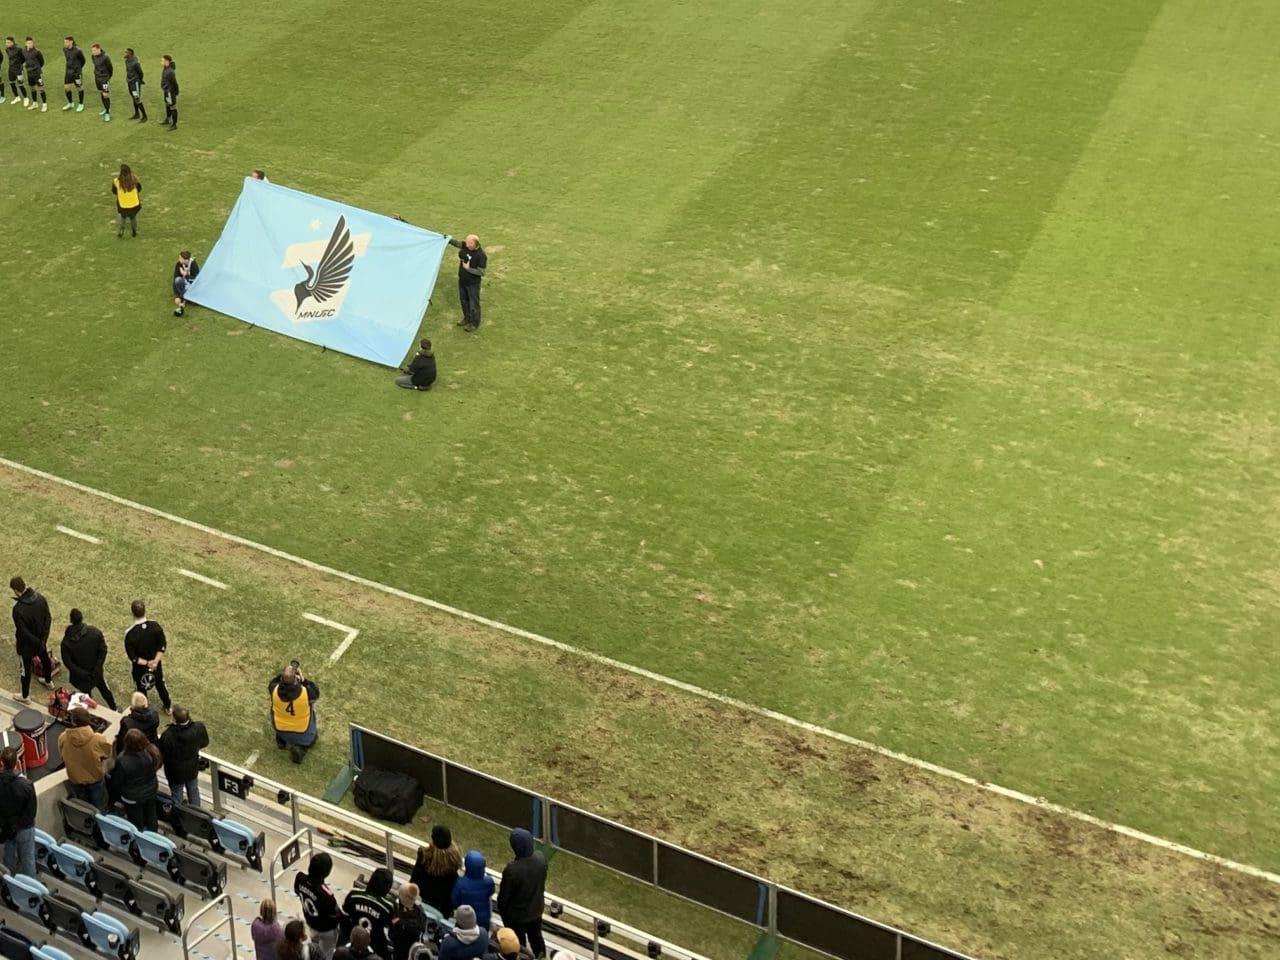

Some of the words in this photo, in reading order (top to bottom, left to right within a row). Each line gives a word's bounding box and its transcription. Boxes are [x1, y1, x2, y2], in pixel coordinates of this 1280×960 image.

[285, 701, 296, 716] 4
[224, 778, 240, 794] F3
[355, 904, 381, 920] MARTINS
